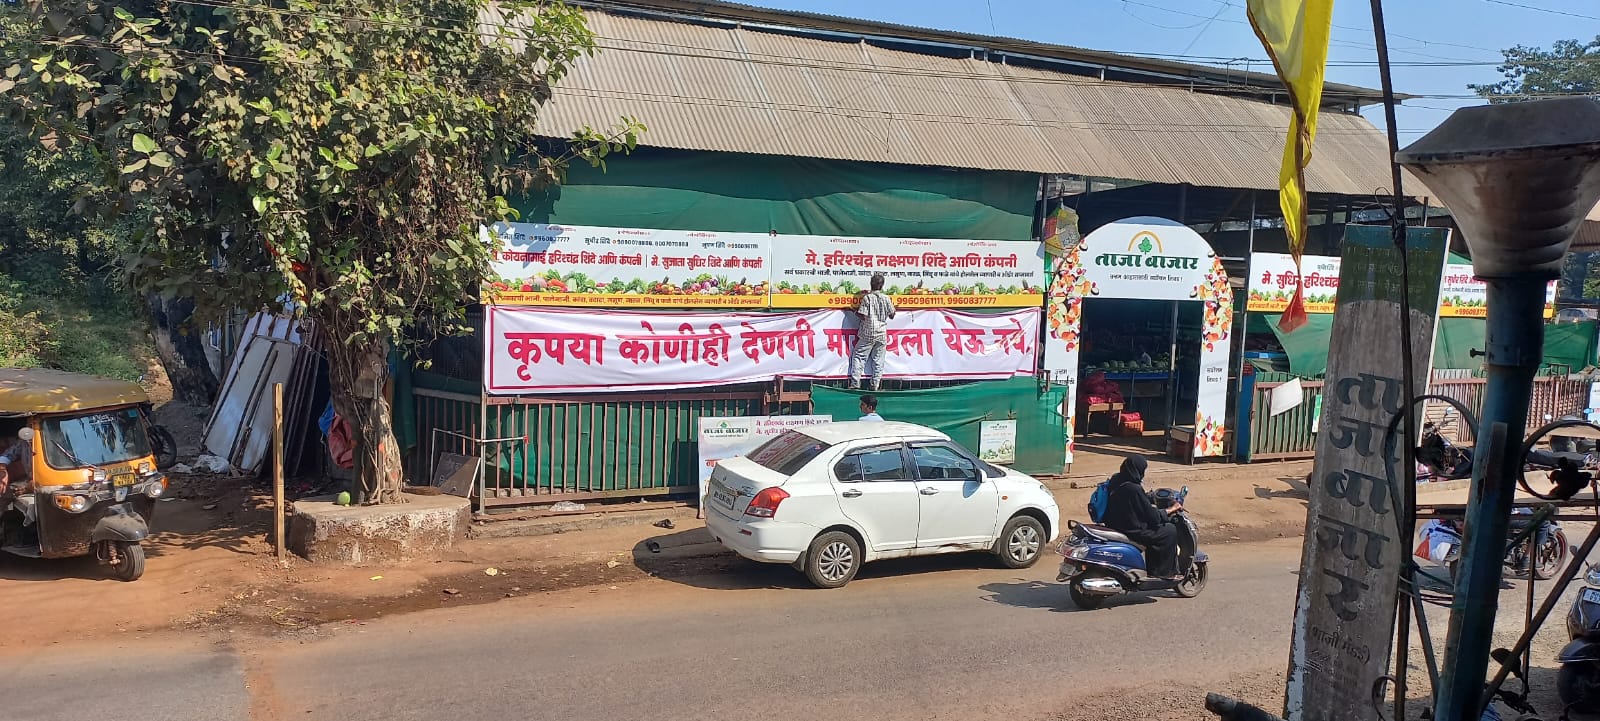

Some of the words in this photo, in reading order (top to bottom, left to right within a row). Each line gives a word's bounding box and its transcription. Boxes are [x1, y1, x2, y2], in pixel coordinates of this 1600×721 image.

[548, 250, 579, 264] हरिश्चंद्र
[581, 251, 597, 265] शिंदे
[598, 252, 617, 265] आणि
[619, 253, 642, 266] कंपनी
[651, 254, 660, 267] मे.
[662, 257, 685, 270] सुजाता
[687, 255, 706, 270] सुधिर
[708, 255, 722, 268] शिंदे
[723, 256, 740, 269] आणि
[742, 257, 763, 269] कंपनी
[805, 249, 820, 266] मे.
[823, 250, 874, 268] हरिश्चंद्र
[876, 255, 919, 268] लक्ष्मण
[922, 252, 947, 268] शिंदे
[950, 253, 982, 268] आणि
[983, 253, 1018, 268] कंपनी
[1095, 252, 1142, 267] ताजा
[1144, 255, 1200, 269] बाजार
[1262, 270, 1273, 285] मे.
[1304, 272, 1341, 288] हरिश्चंद्र
[897, 297, 946, 306] 9960961111,
[947, 297, 997, 305] 9960837777
[504, 332, 606, 381] कृपया
[616, 320, 732, 366] कोणीही
[740, 318, 816, 364] देणगी
[823, 329, 934, 358] मायला
[941, 315, 986, 356] येऊ
